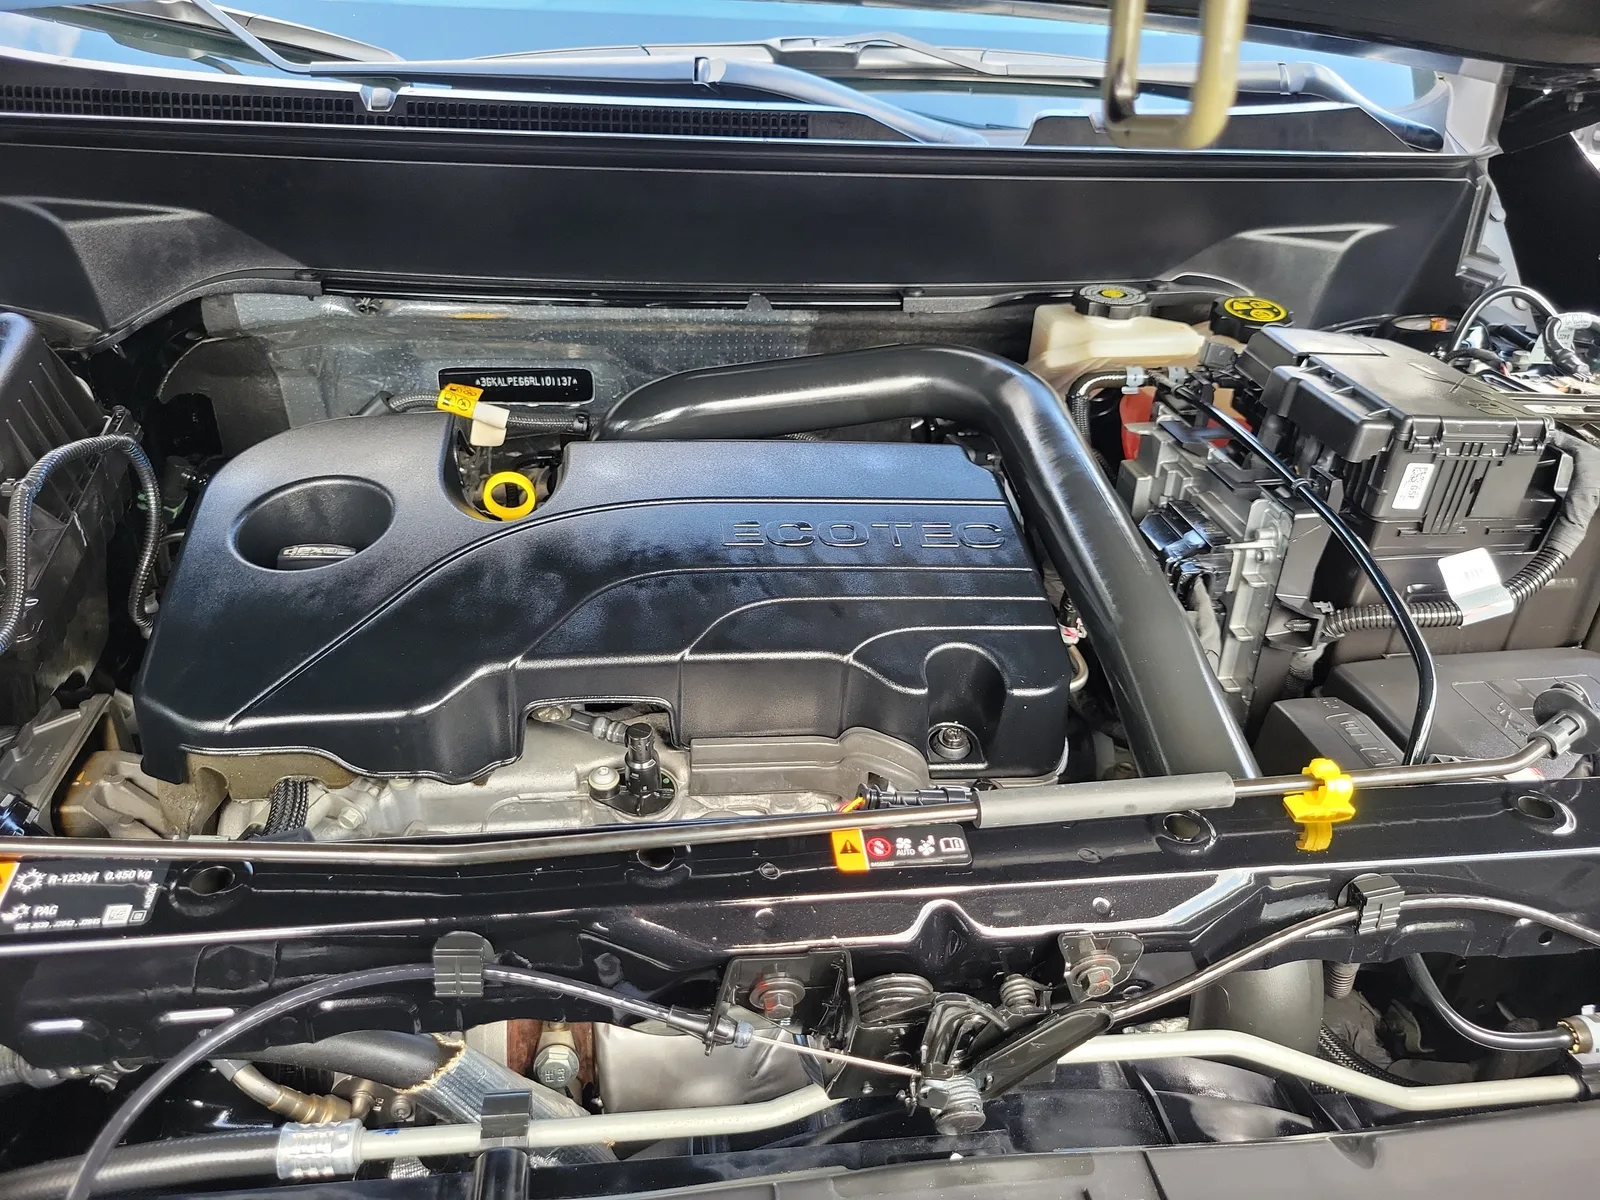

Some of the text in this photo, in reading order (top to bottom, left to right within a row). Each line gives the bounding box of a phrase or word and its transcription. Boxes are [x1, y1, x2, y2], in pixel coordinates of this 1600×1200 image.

[721, 520, 1006, 549] ECOTEC
[48, 868, 153, 884] R-1234yf 0.450 kg
[33, 905, 59, 916] PAG
